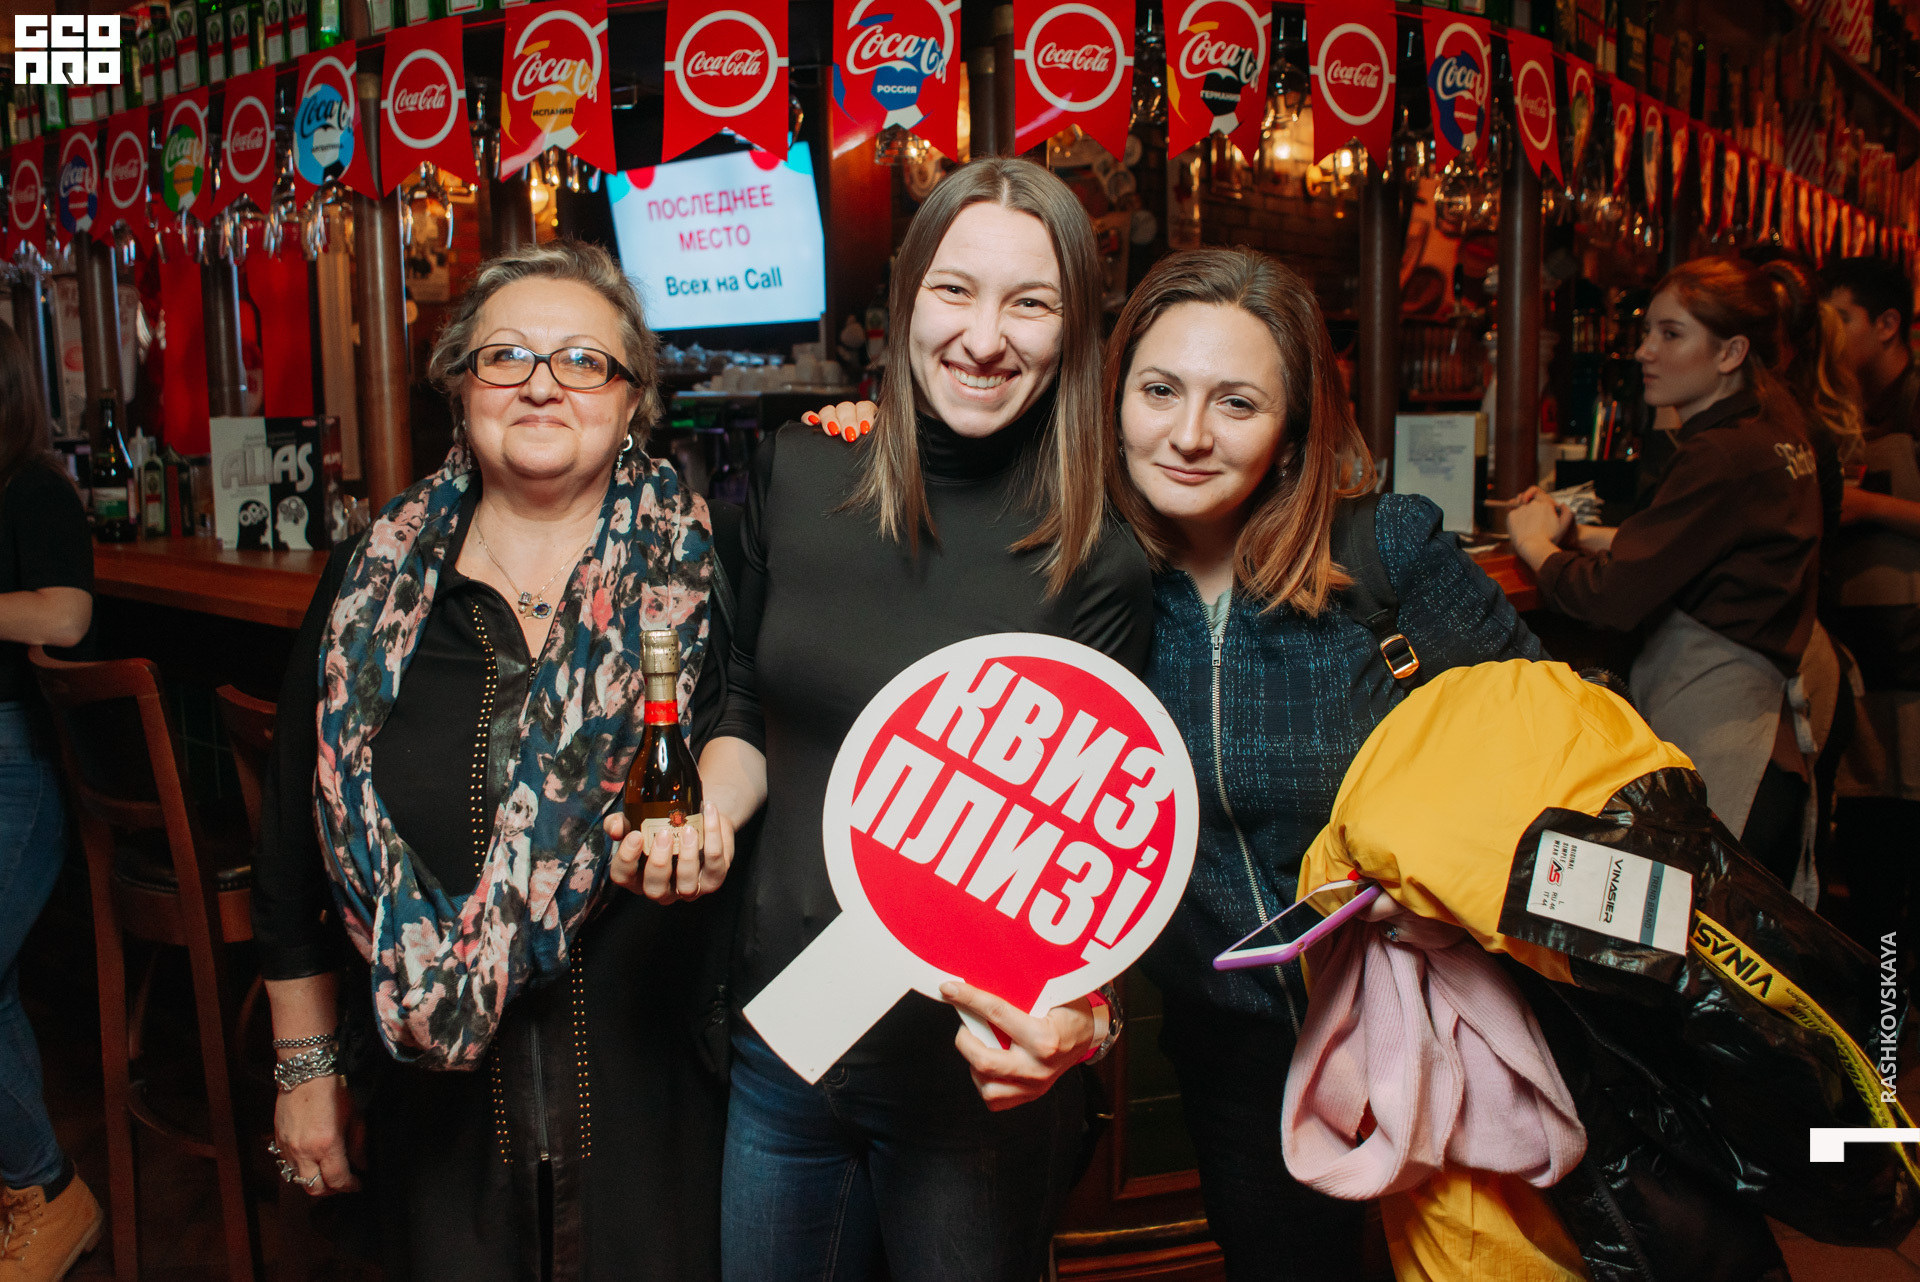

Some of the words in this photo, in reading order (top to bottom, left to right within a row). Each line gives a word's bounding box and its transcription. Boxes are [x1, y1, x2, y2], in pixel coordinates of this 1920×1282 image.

[686, 49, 765, 78] Coca-Cola
[1037, 42, 1114, 73] Coca-Cola
[1327, 59, 1380, 88] Coca-Cola
[394, 83, 449, 114] Coca-Cola
[877, 85, 917, 94] РОССИЯ
[532, 107, 574, 117] ИСПАНИЯ
[648, 184, 774, 221] ПОСЛЕДНЕЕ
[679, 224, 751, 252] МЕСТО
[665, 276, 711, 296] Всех
[716, 276, 739, 292] на
[744, 266, 782, 289] Call
[915, 659, 1174, 868] КВИЗ,
[850, 734, 1152, 963] ПЛИЗ!
[1603, 859, 1623, 923] VINASIER
[1649, 876, 1659, 900] TREND
[1644, 901, 1654, 929] BRAND
